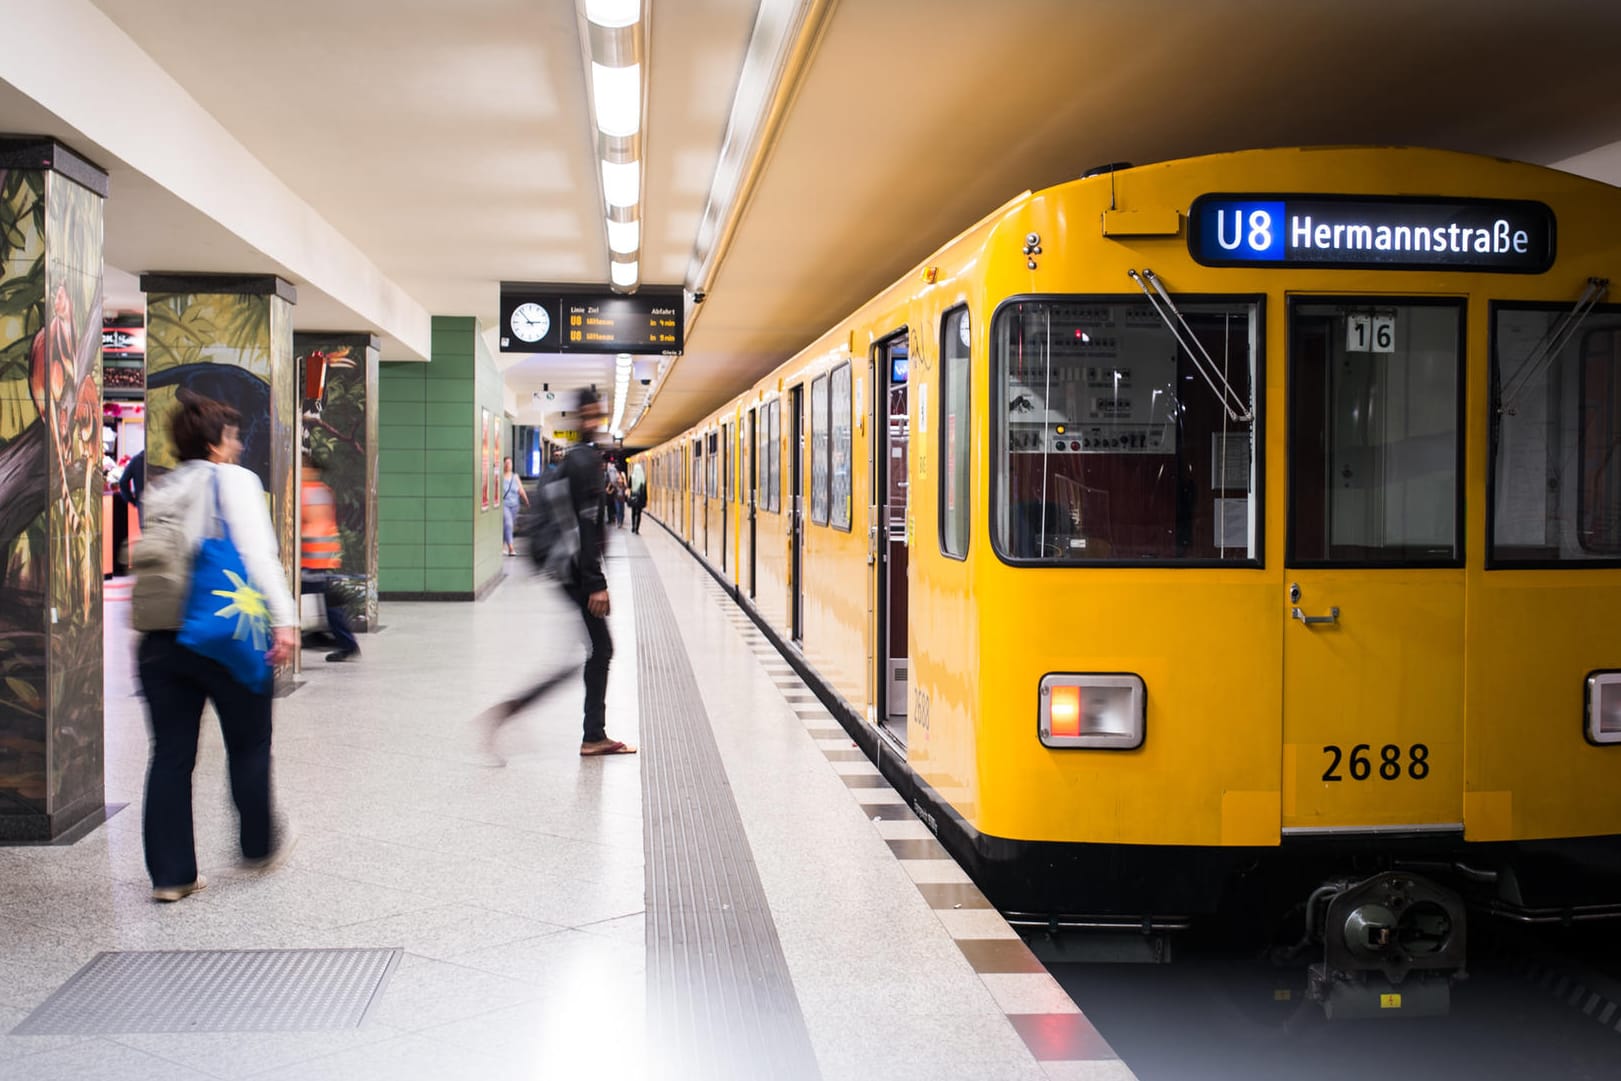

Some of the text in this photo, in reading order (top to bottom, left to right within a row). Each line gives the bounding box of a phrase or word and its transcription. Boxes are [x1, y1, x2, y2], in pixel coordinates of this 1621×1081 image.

[1217, 210, 1528, 253] U8 Hermannstraße
[1322, 744, 1430, 782] 2688
